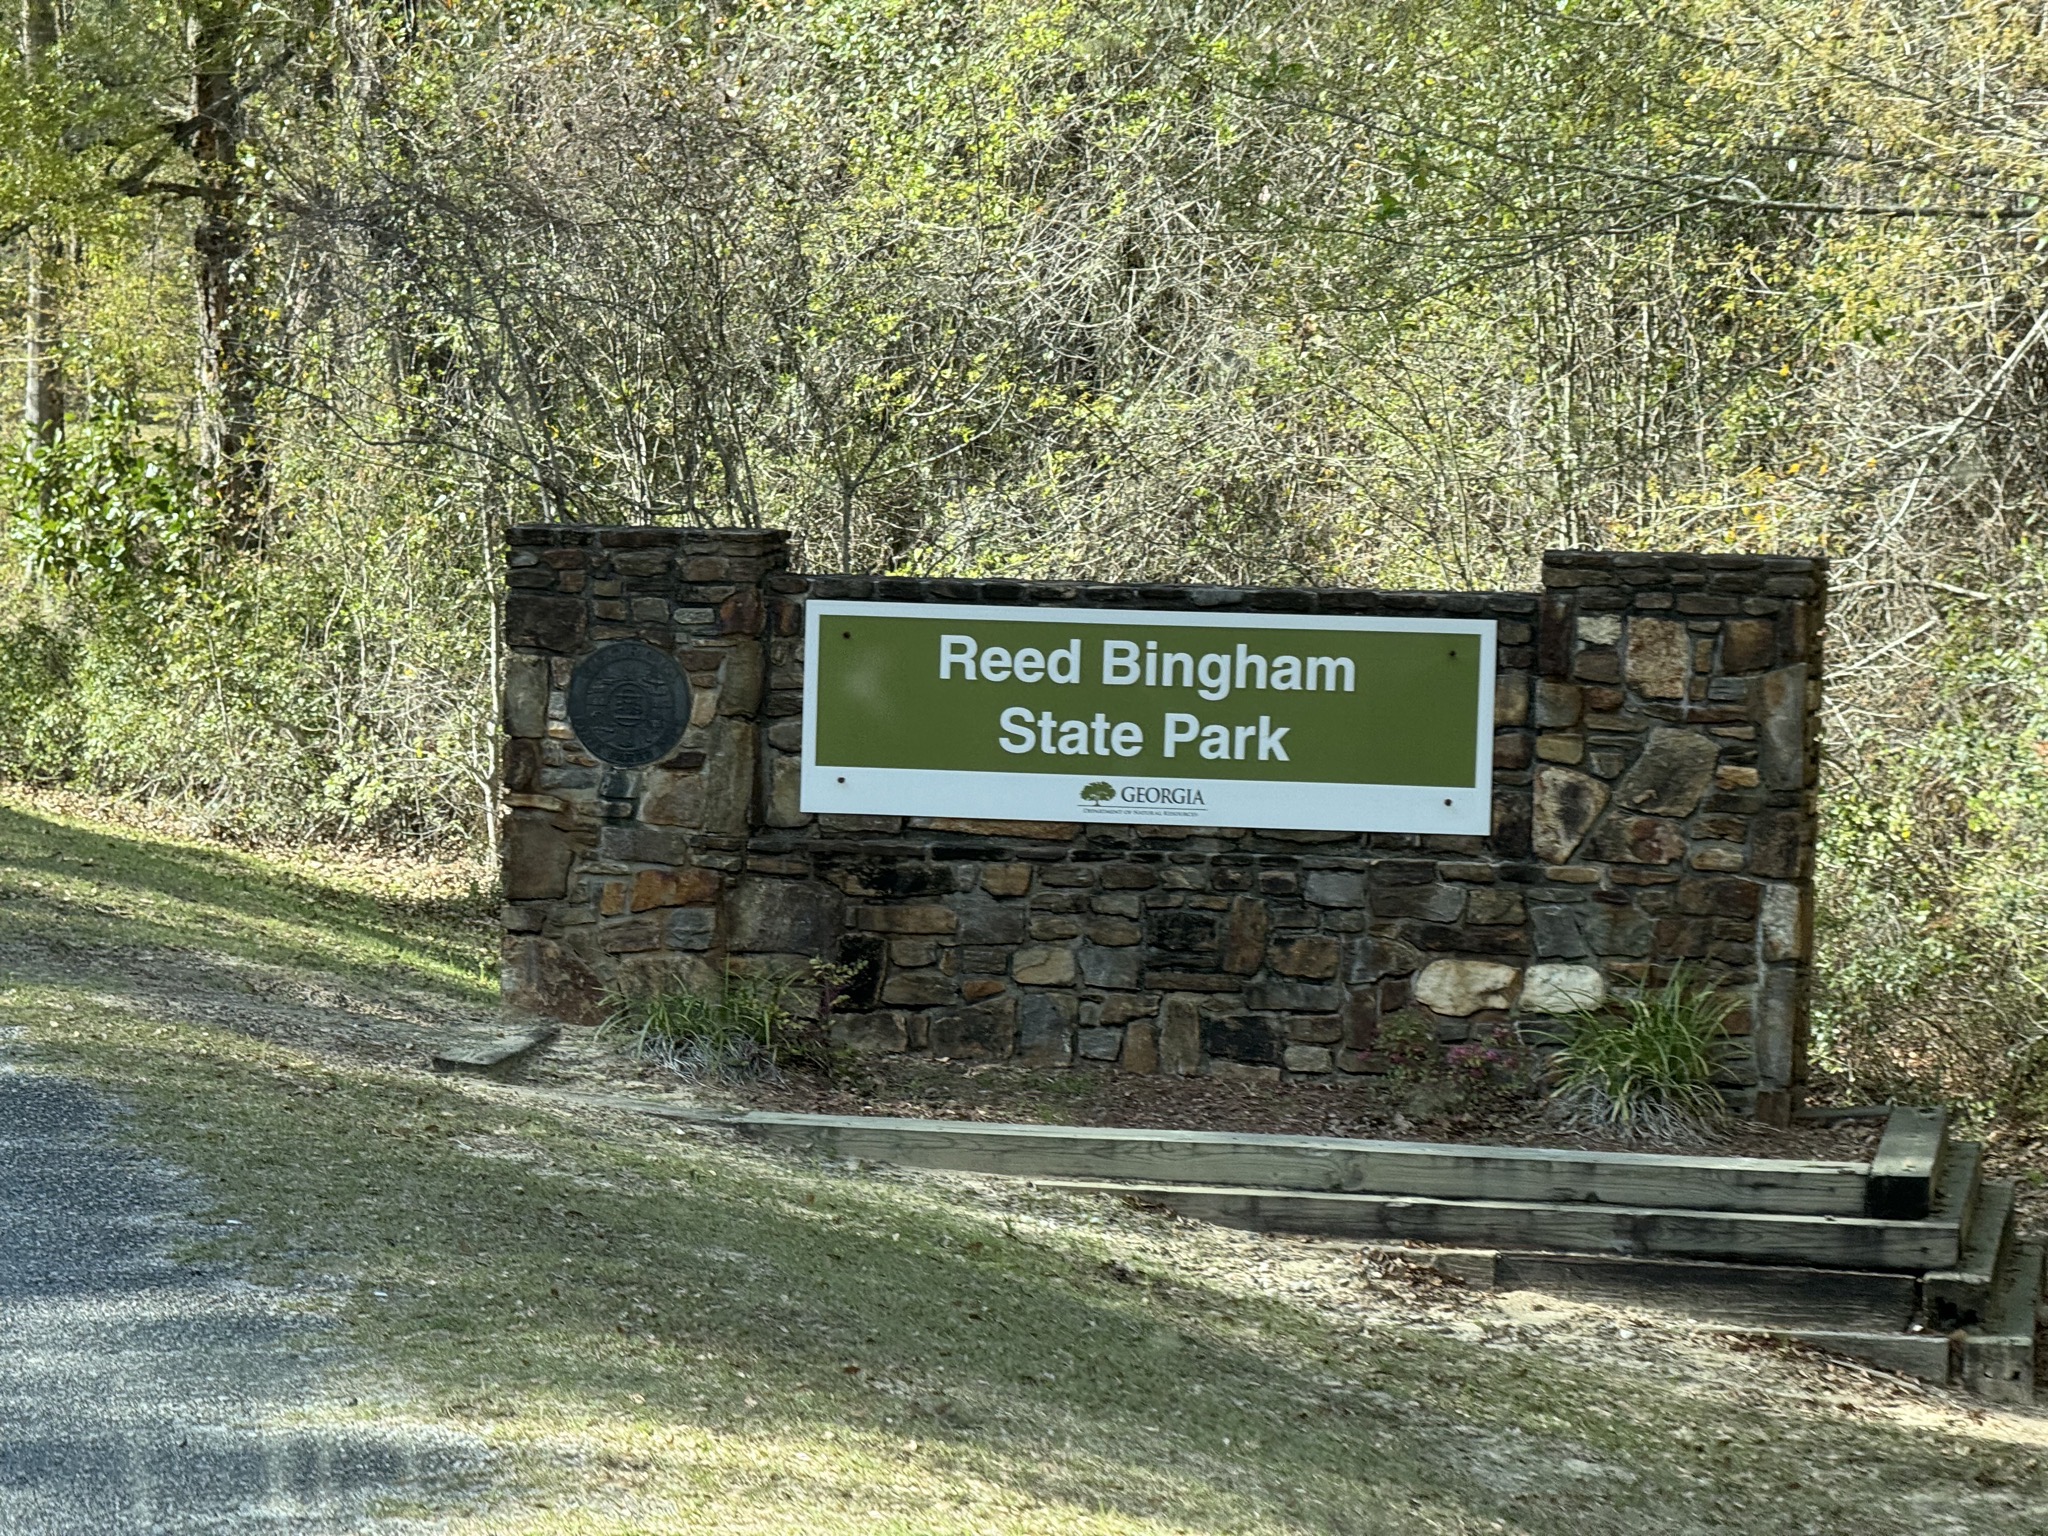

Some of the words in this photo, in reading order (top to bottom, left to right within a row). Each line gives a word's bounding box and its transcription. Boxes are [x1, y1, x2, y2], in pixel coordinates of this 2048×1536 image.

[940, 635, 1081, 684] Reed
[1102, 640, 1355, 701] Bingham
[999, 707, 1144, 757] State
[1163, 713, 1290, 761] Park
[1121, 786, 1205, 805] GEORGIA
